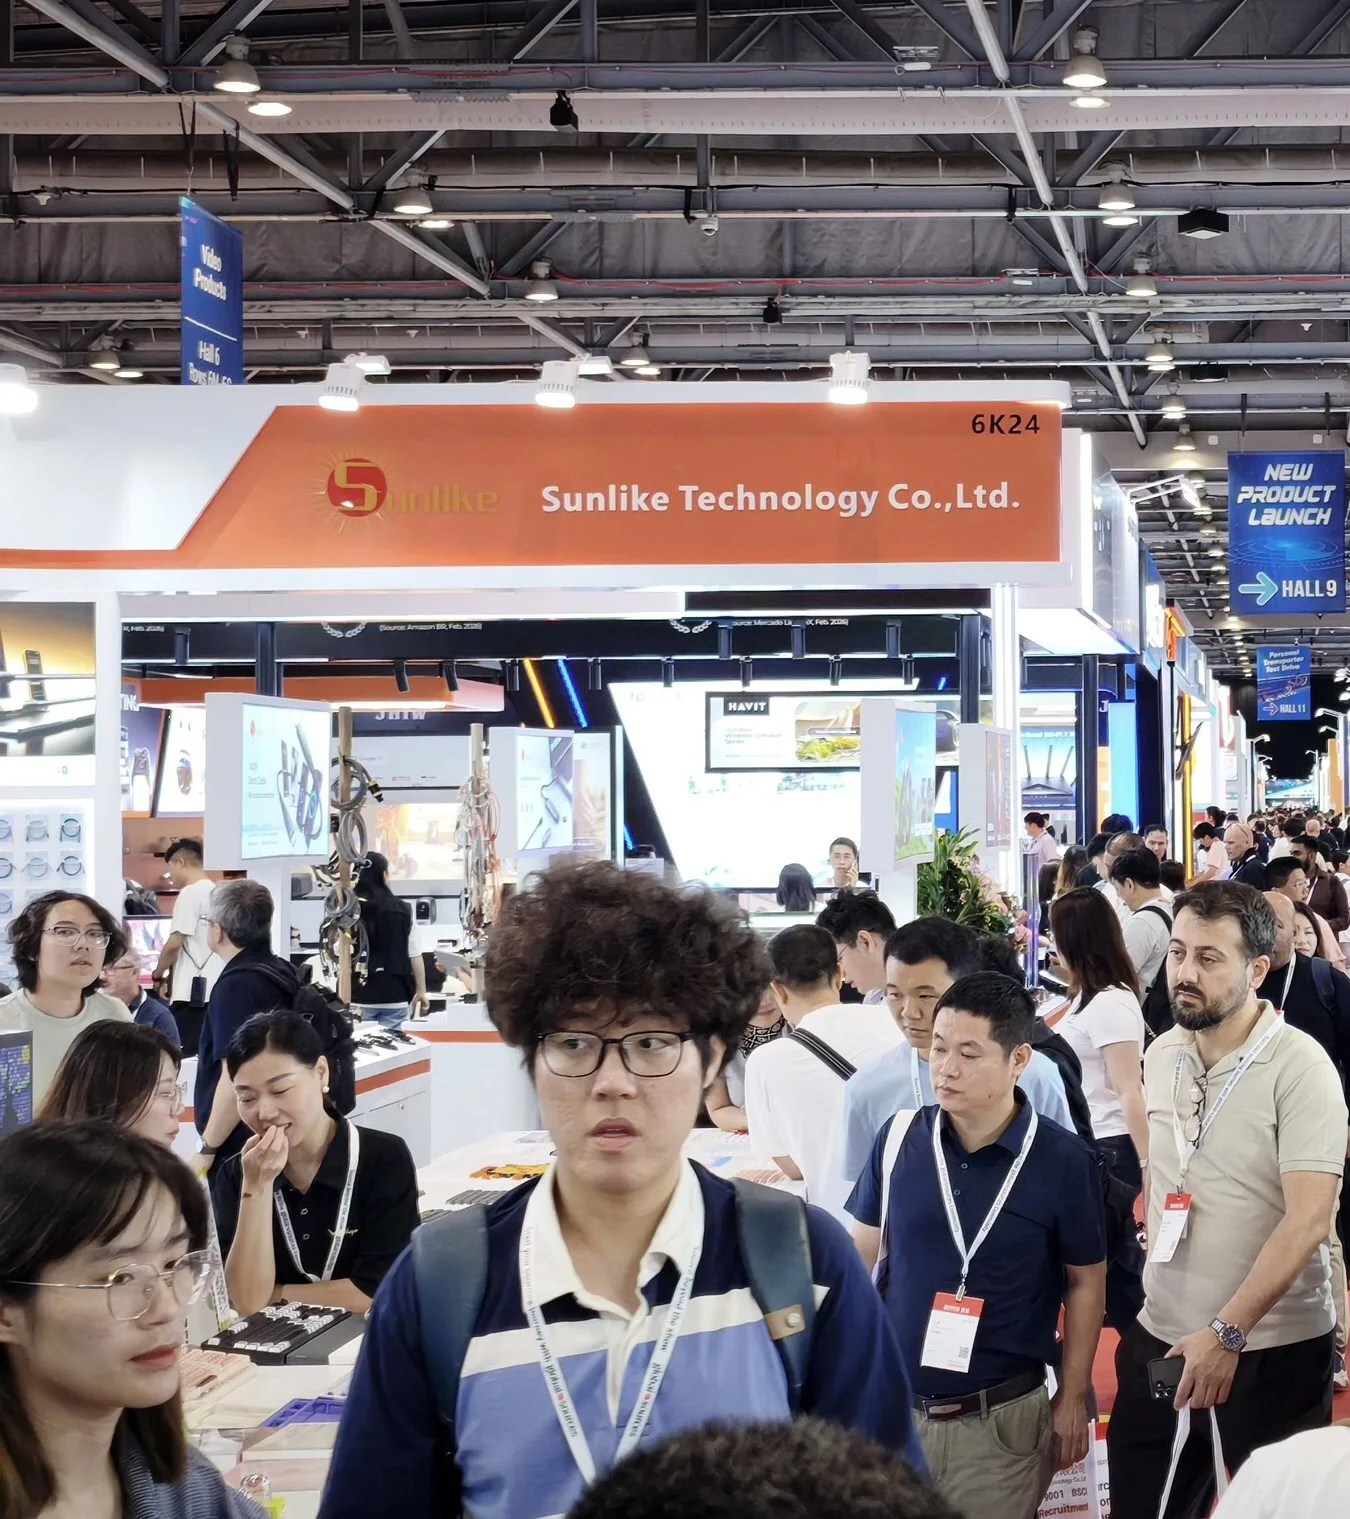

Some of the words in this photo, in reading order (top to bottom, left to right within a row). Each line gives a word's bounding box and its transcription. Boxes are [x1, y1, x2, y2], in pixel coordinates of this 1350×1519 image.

[201, 244, 222, 272] Video
[193, 268, 227, 300] Products
[198, 340, 214, 364] Hall
[214, 347, 220, 366] 6
[971, 413, 1040, 435] 6K24
[1264, 463, 1314, 482] NEW
[334, 461, 499, 514] Sunlike
[1236, 485, 1336, 504] PRODUCT
[541, 484, 670, 513] Sunlike
[678, 482, 878, 518] Technology
[888, 482, 1020, 513] Co.,Ltd.
[1282, 579, 1324, 598] HALL
[1326, 579, 1337, 598] 9
[1263, 656, 1304, 666] Transporter
[1269, 650, 1300, 658] Personal
[728, 702, 767, 712] HAVIT
[1280, 704, 1296, 713] HALL
[1298, 704, 1306, 713] 11
